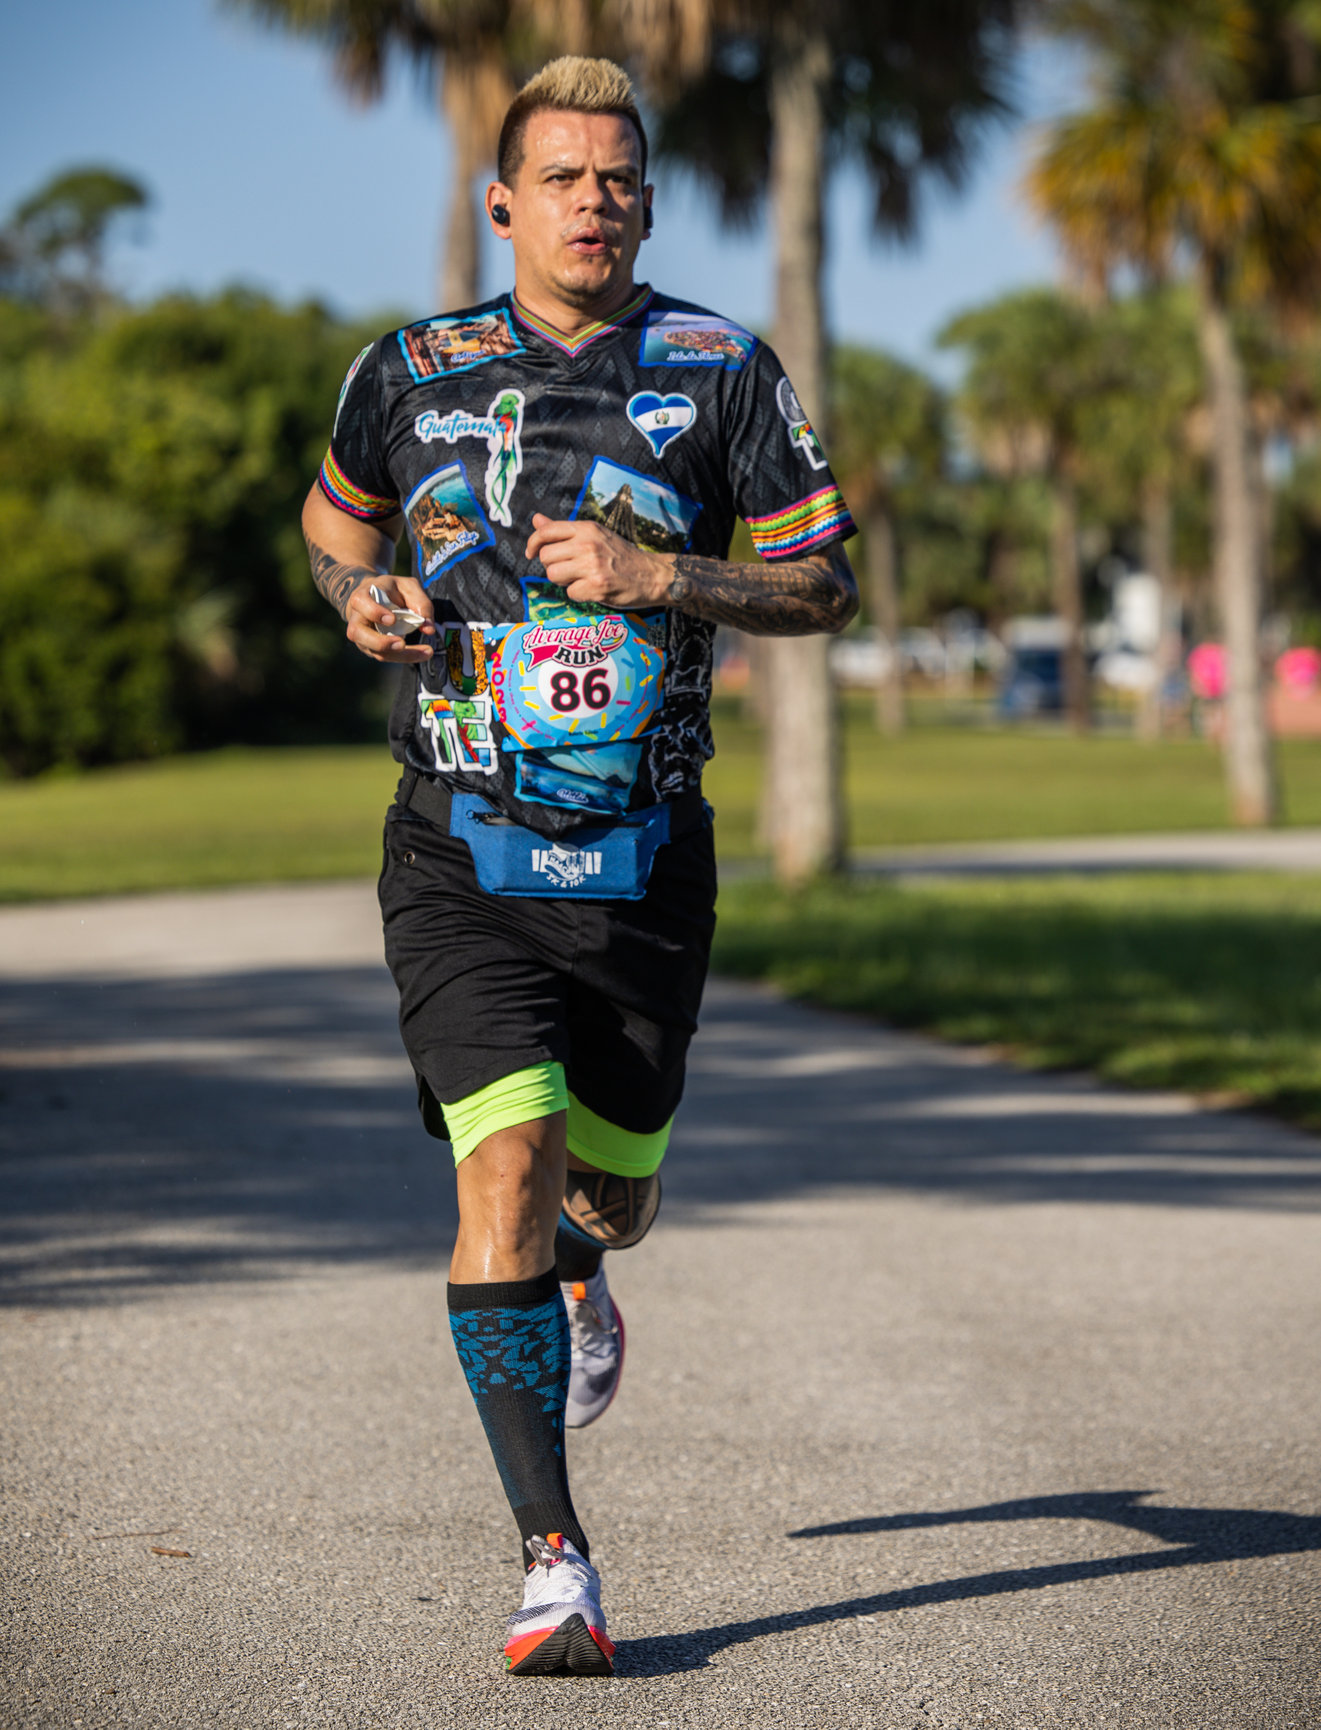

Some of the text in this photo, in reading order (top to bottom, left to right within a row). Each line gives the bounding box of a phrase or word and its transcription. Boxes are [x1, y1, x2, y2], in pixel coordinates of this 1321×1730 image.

[418, 413, 507, 439] Guatemala
[524, 619, 624, 648] Average Joe
[554, 646, 604, 665] RUN
[491, 652, 507, 723] 2023
[550, 668, 611, 712] 86
